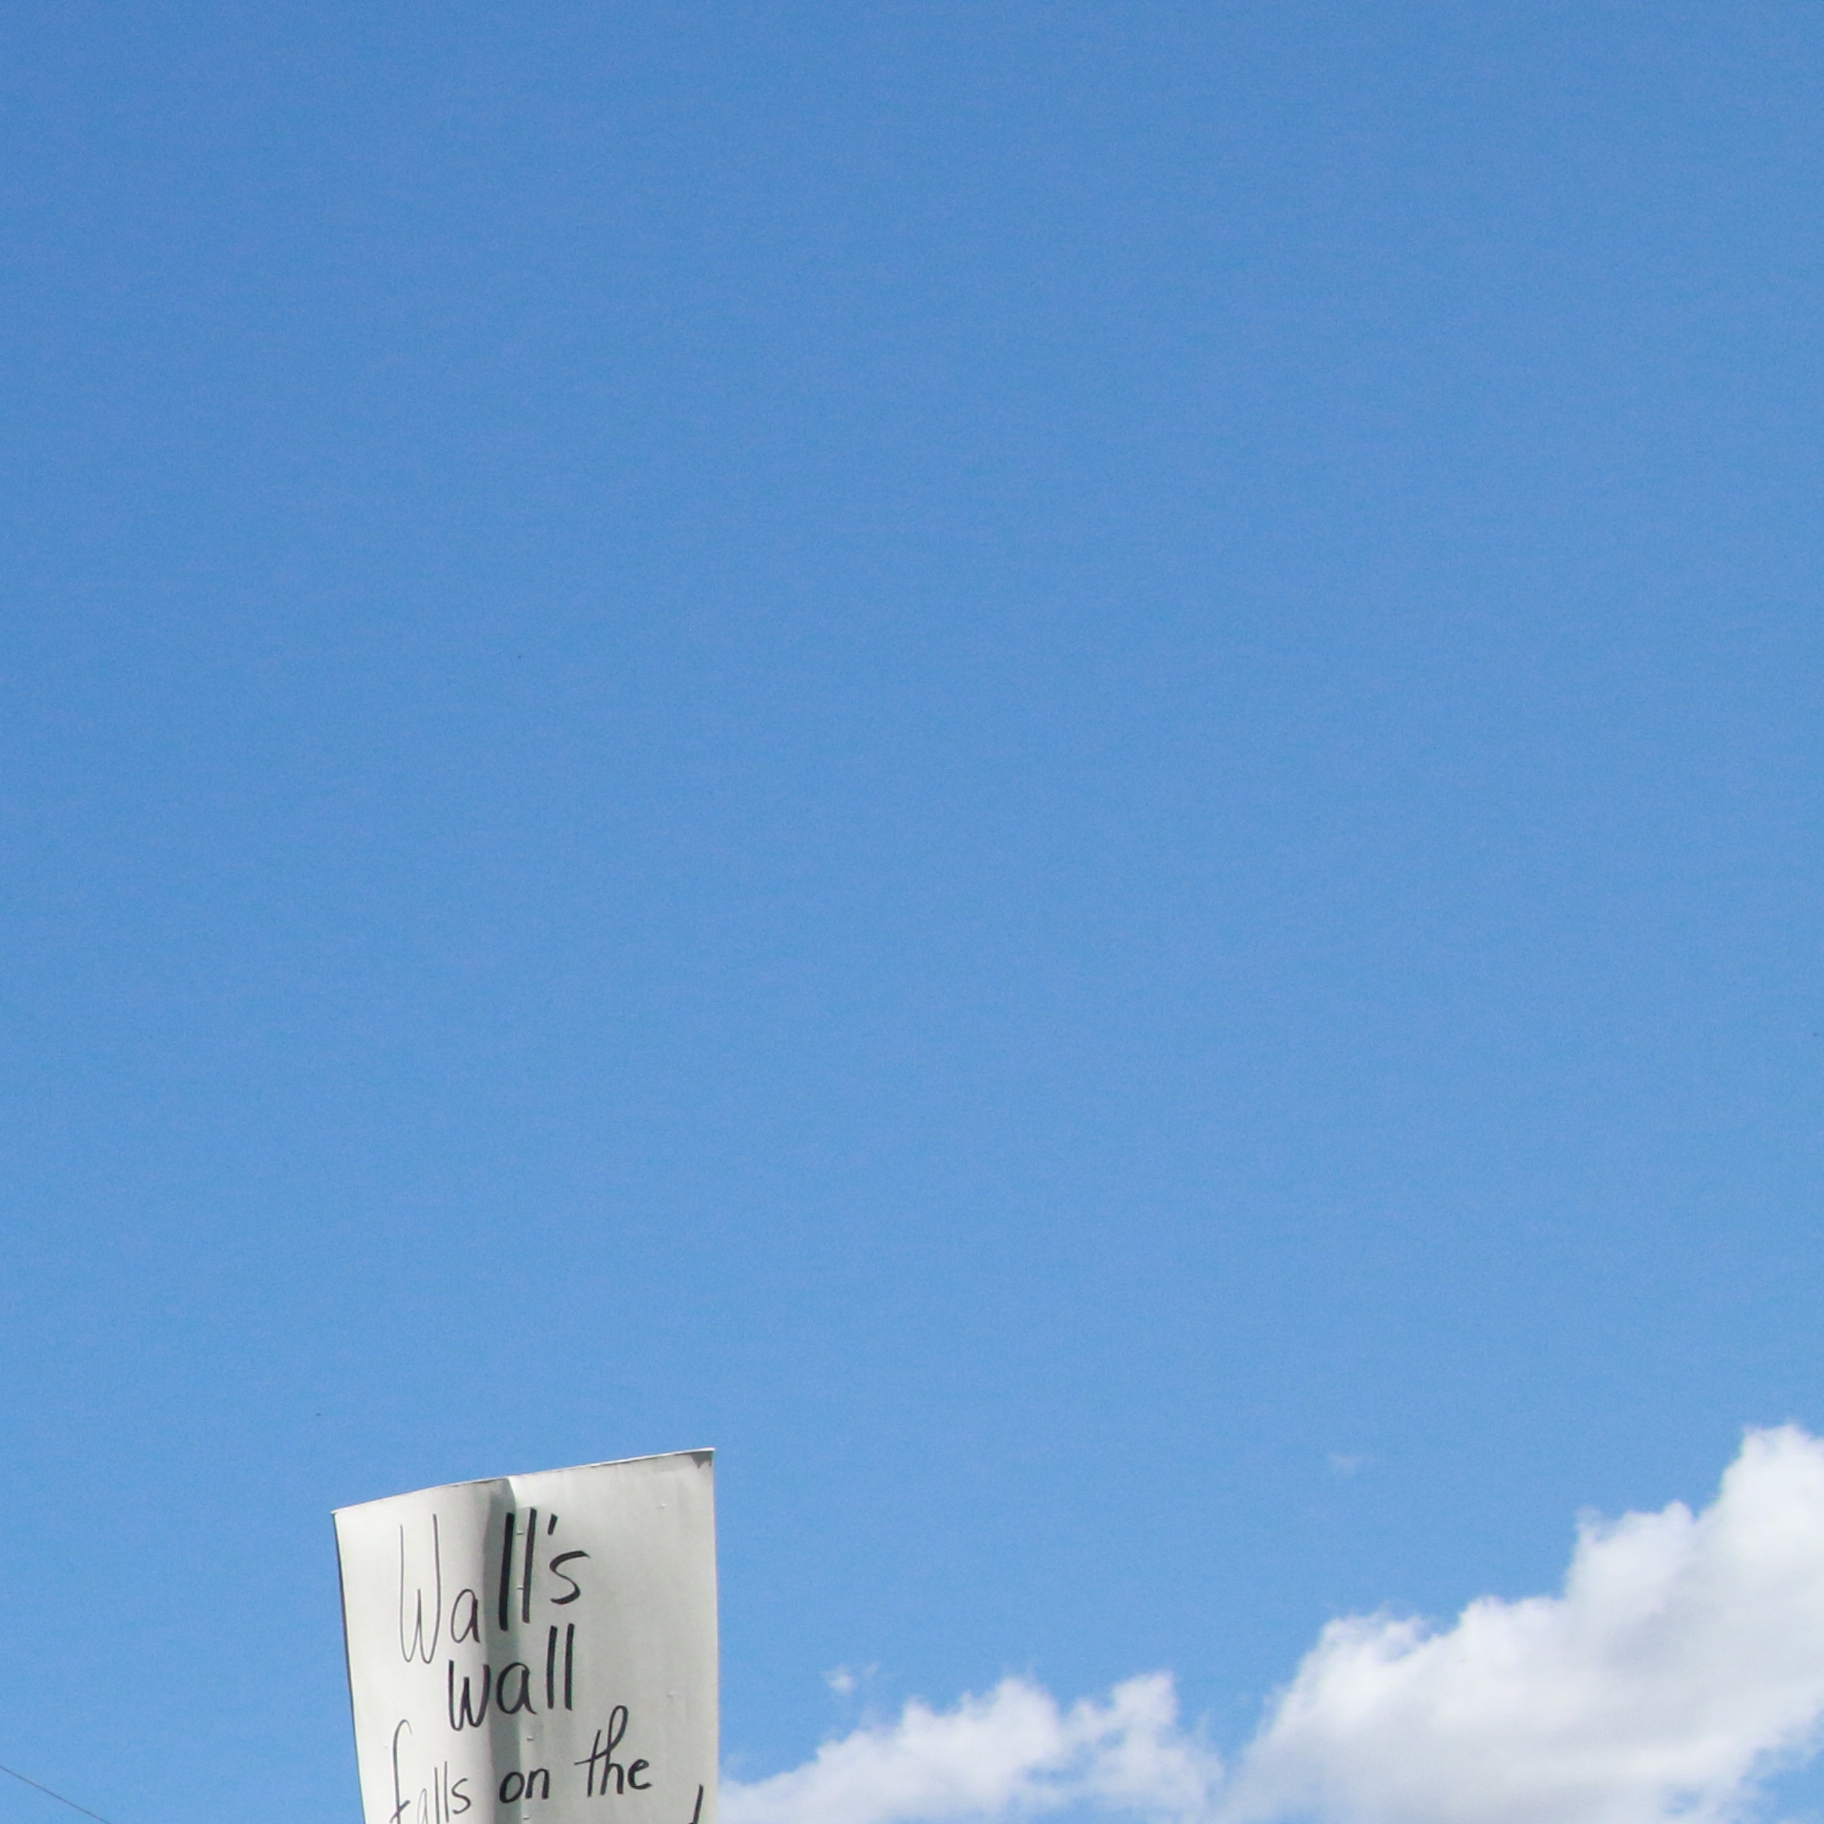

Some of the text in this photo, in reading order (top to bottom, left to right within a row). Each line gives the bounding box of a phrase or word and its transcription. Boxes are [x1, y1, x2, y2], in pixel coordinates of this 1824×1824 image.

[399, 1507, 591, 1665] Wall's
[448, 1622, 576, 1731] wall
[498, 1766, 551, 1804] on
[574, 1704, 652, 1798] the
